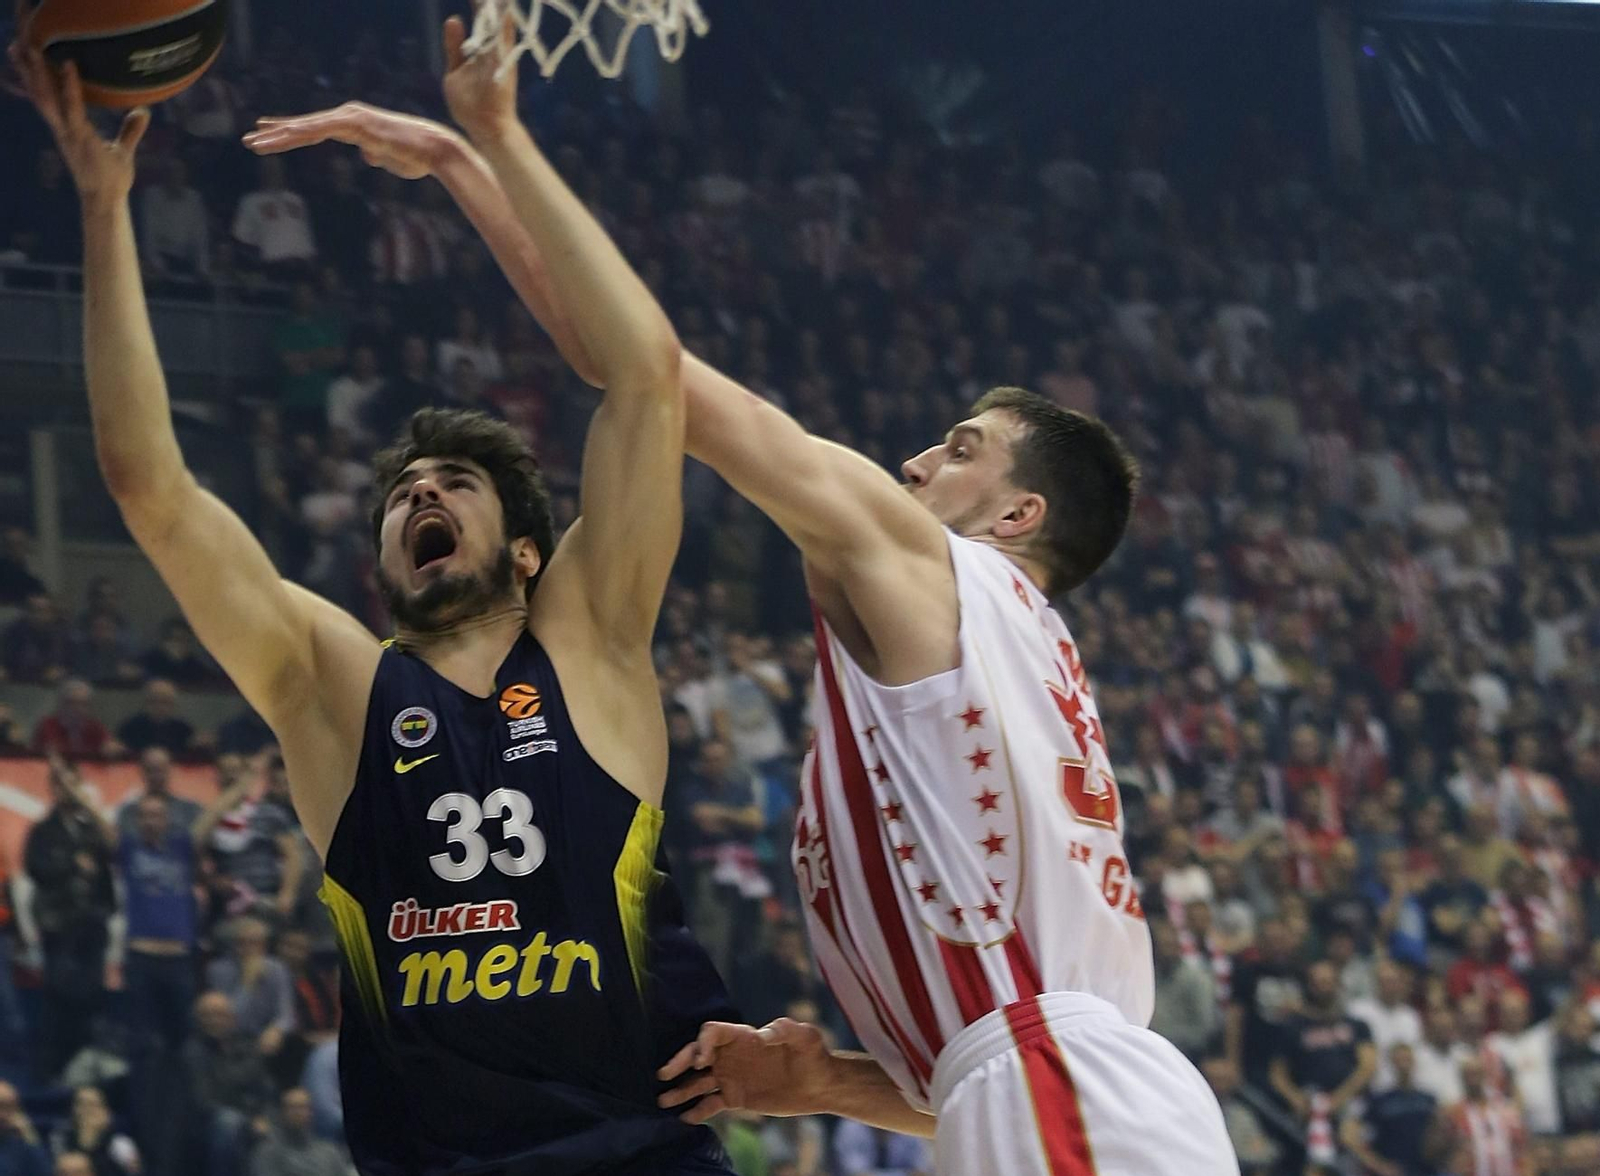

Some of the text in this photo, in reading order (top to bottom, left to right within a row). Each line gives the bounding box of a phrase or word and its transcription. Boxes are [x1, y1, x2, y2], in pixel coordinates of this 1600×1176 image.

[427, 788, 547, 882] 33
[388, 898, 521, 942] ÜLKER
[398, 931, 602, 1007] metr
